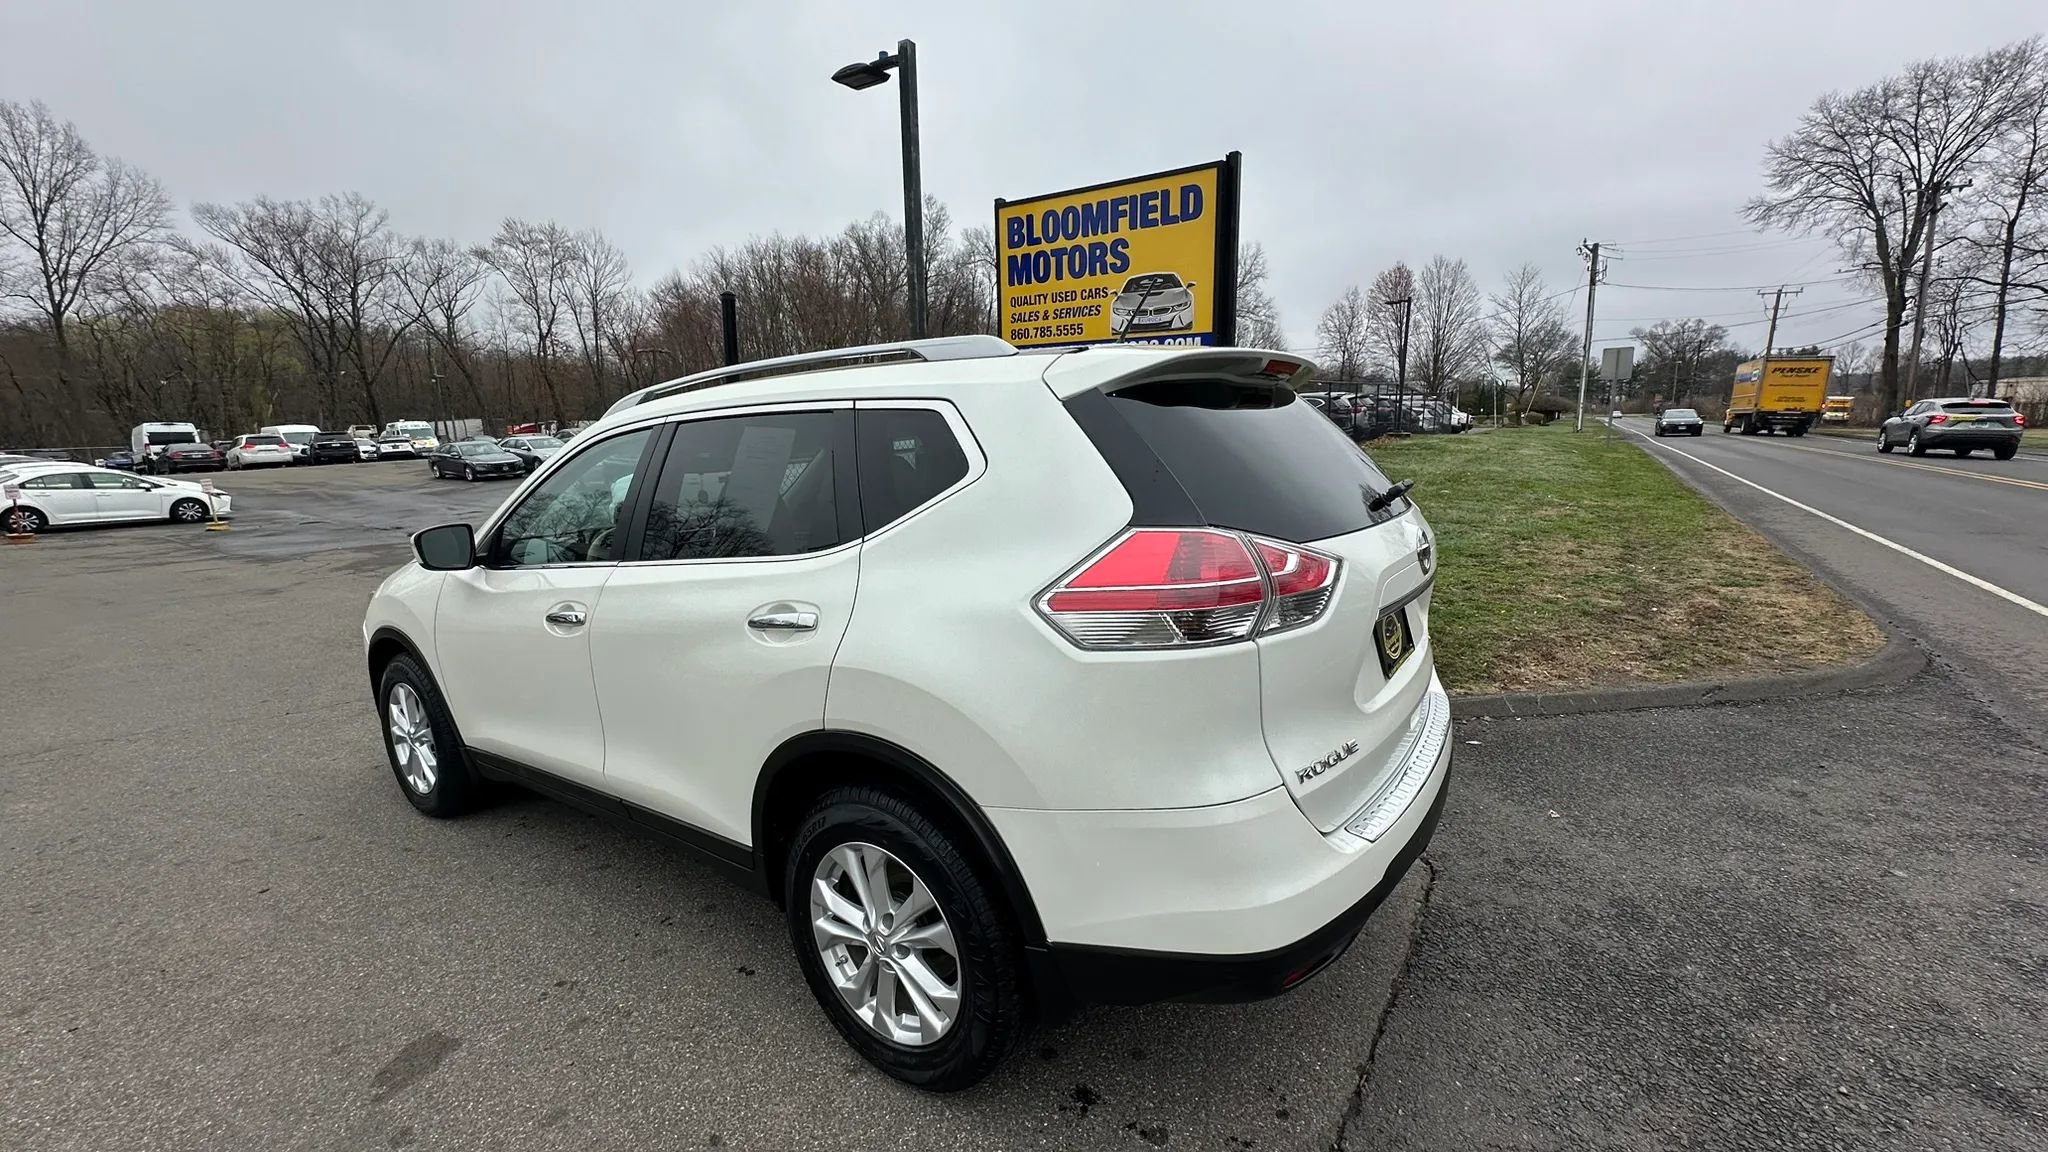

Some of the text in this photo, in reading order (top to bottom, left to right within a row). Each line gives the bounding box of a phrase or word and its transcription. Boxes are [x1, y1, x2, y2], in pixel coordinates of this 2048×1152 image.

[1007, 184, 1203, 249] BLOOMFIELD
[1007, 238, 1130, 287] MOTORS
[1010, 287, 1109, 308] QUALITY USED CARS
[1010, 305, 1102, 324] SALES & SERVICES
[1010, 323, 1084, 341] 860.785.5555
[1294, 738, 1360, 785] ROGUE
